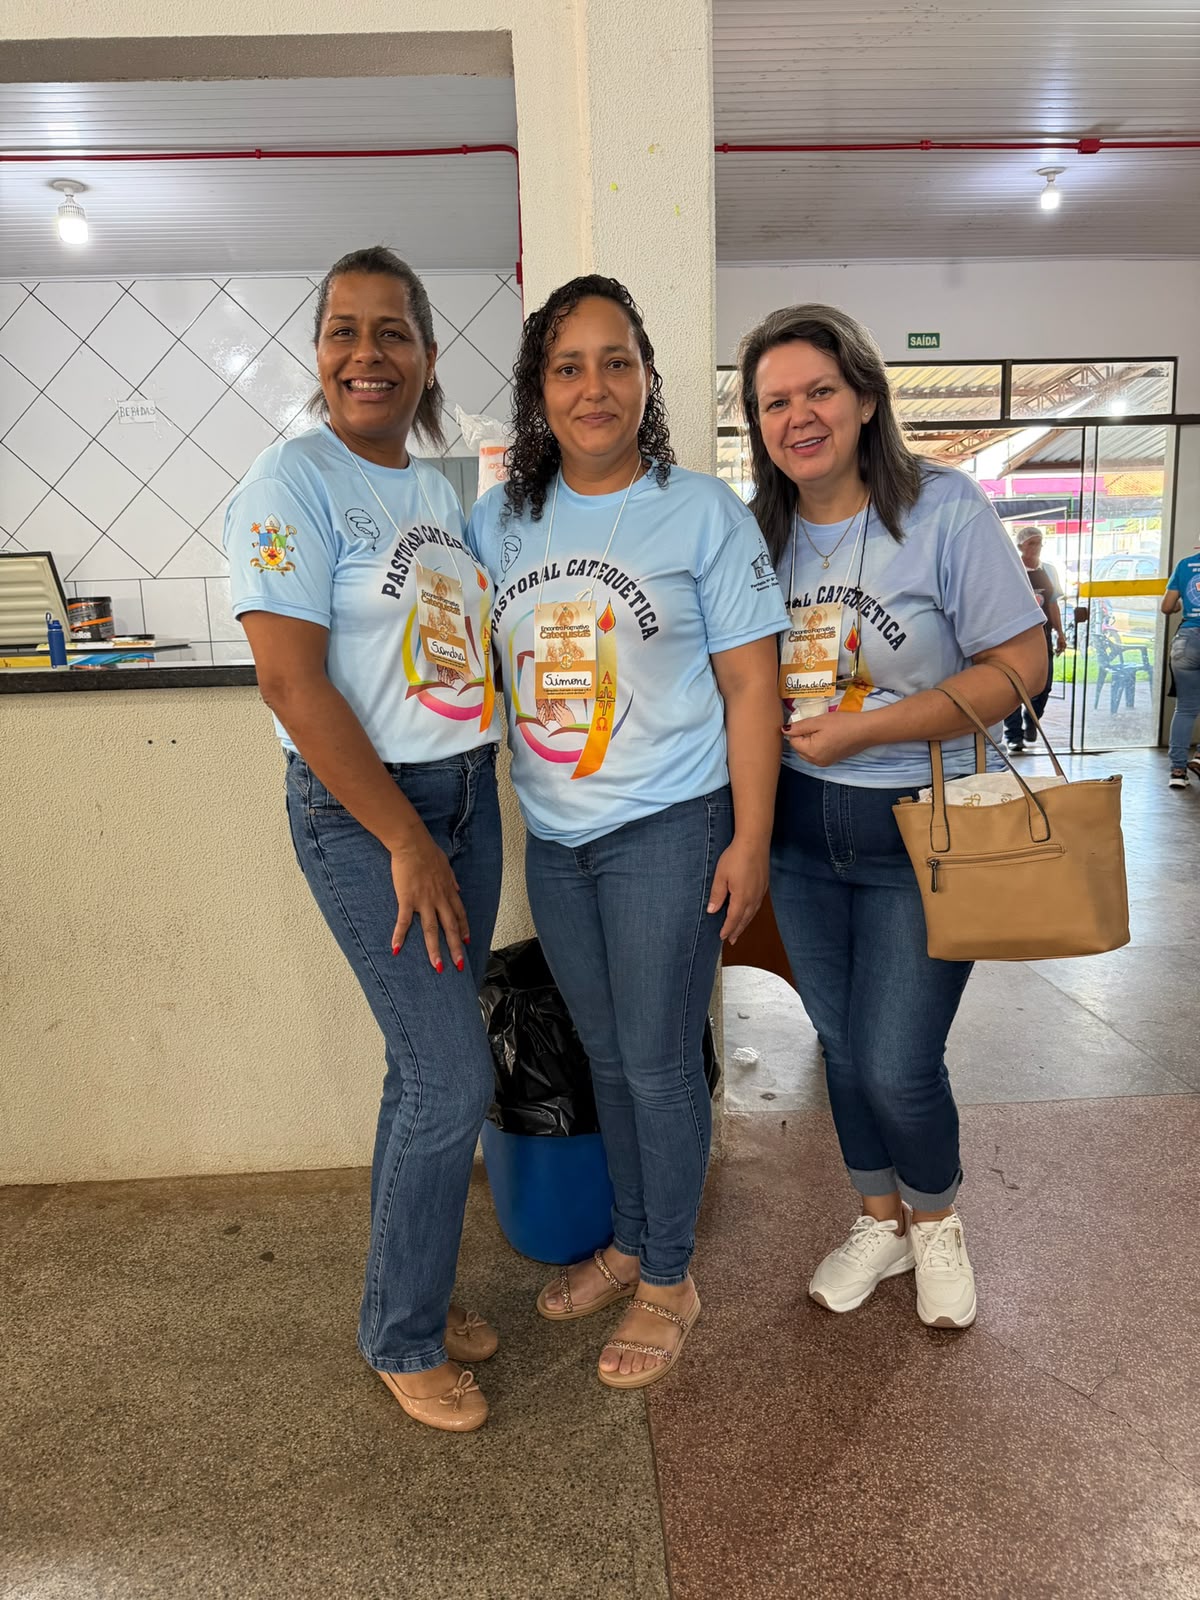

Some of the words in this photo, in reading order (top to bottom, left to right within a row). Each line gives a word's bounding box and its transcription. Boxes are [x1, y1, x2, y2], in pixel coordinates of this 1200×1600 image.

[910, 335, 938, 346] SAÍDA
[119, 406, 155, 417] BEBIDAS
[490, 562, 560, 634] PASTORAL
[566, 559, 659, 641] CATEQUÉTICA
[540, 630, 591, 640] Catequistas
[788, 632, 836, 642] Catequistas
[431, 641, 466, 662] Sandra
[545, 674, 591, 687] Simone
